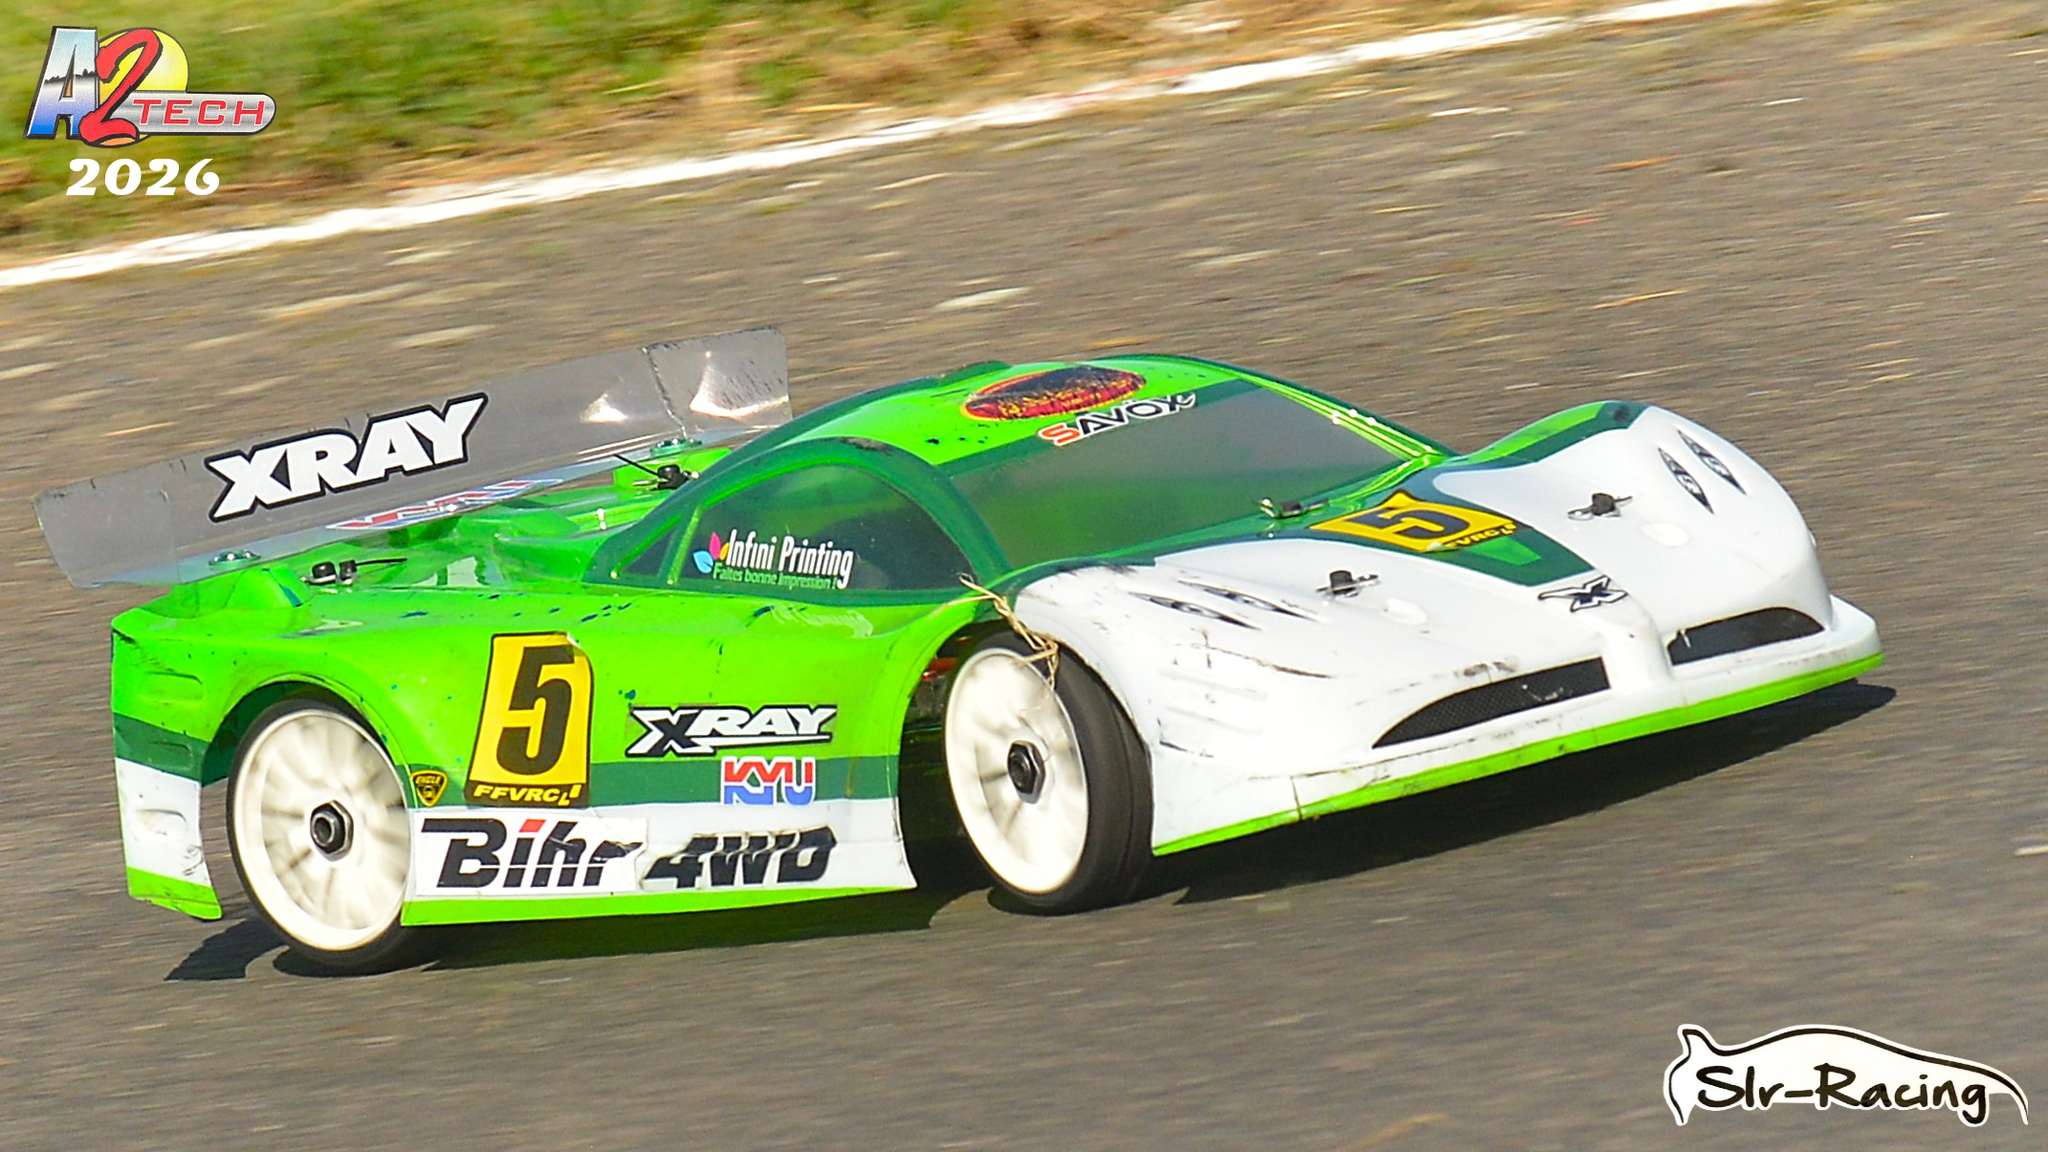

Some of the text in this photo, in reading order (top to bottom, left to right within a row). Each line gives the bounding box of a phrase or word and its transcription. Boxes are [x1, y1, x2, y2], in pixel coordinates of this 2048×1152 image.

[204, 392, 488, 522] XRAY
[1344, 508, 1471, 540] 5
[725, 529, 854, 589] Infini Printing
[744, 569, 777, 584] bonne
[496, 643, 575, 776] 5
[625, 704, 838, 758] XRAY
[720, 756, 816, 806] KYU
[420, 817, 643, 888] Bihr
[640, 824, 838, 890] 4WD
